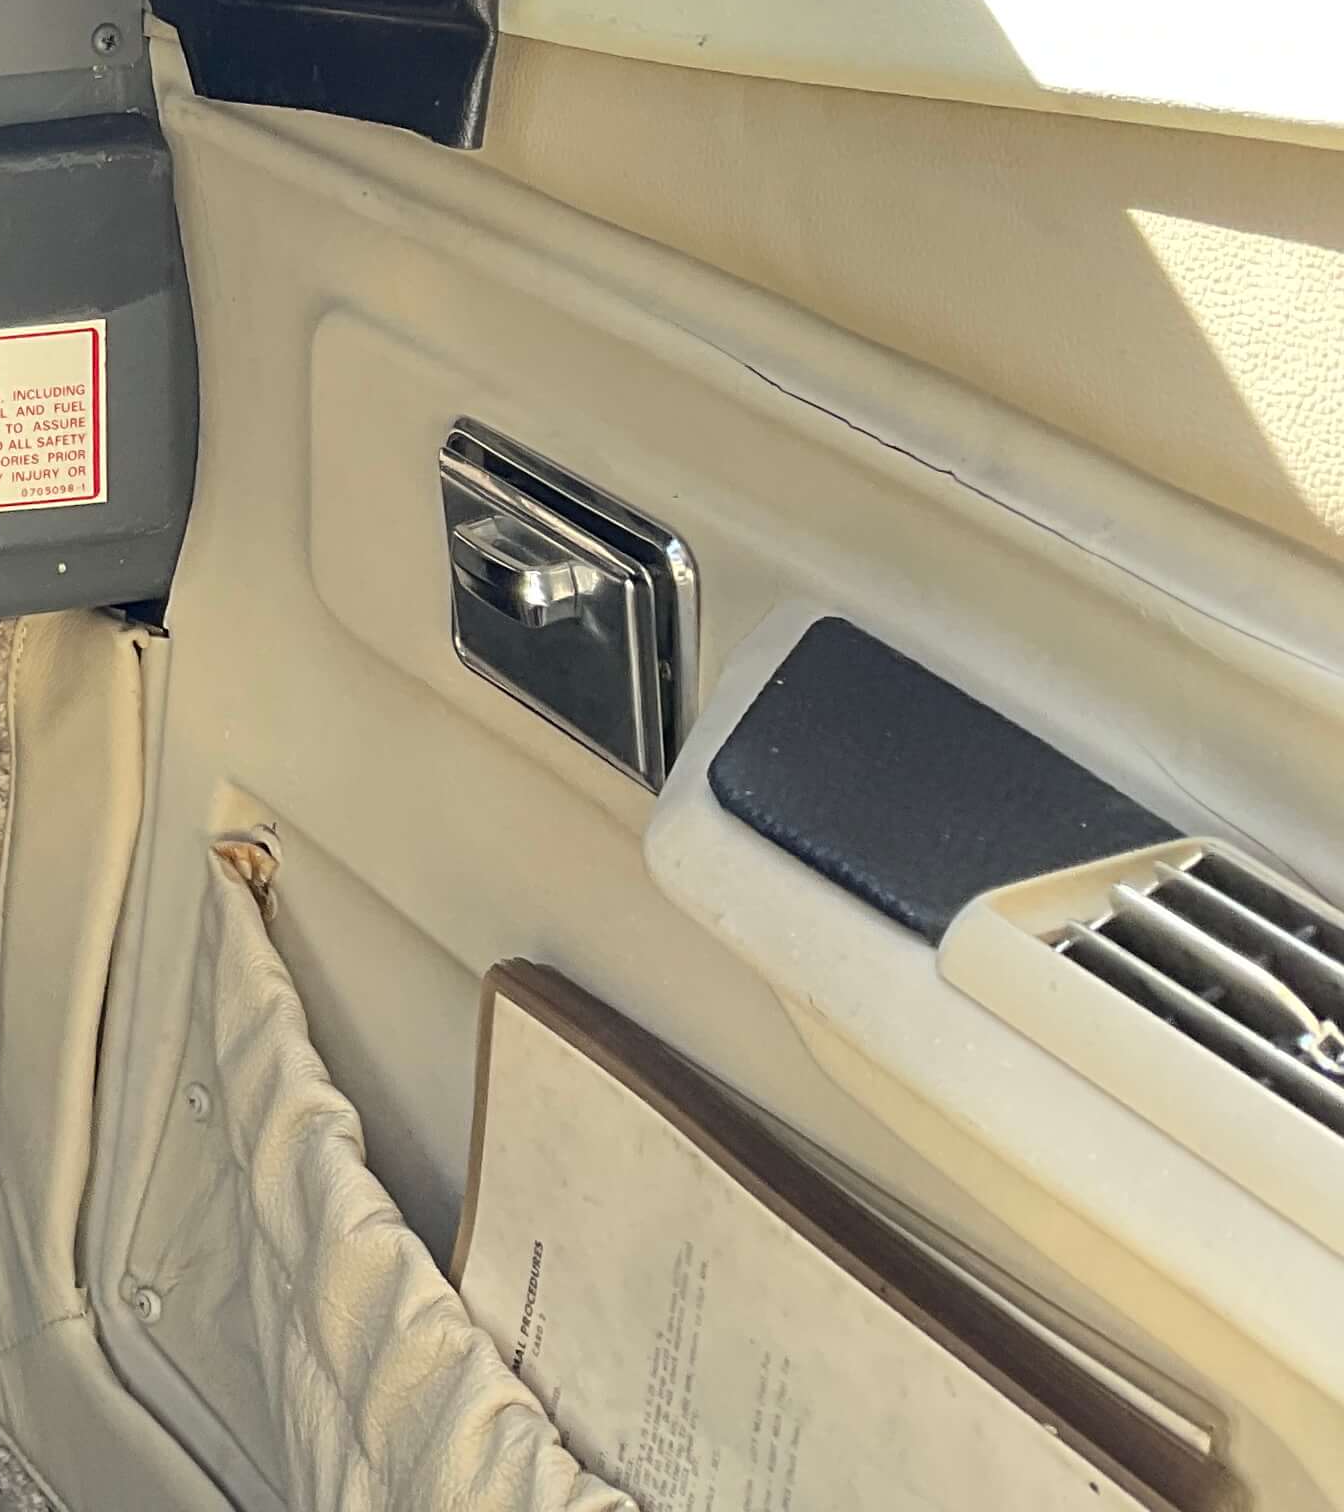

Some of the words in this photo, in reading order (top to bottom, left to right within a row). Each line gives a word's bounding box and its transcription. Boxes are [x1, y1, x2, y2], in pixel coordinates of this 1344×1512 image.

[13, 384, 85, 400] INCLUDING
[16, 404, 45, 417] AND
[54, 401, 85, 413] FUEL
[6, 423, 23, 434] TO
[33, 418, 85, 432] ASSURE
[9, 438, 32, 450] ALL
[37, 434, 86, 448] SAFETY
[48, 450, 86, 462] PRIOR
[12, 470, 59, 482] INJURY
[68, 466, 86, 477] OR
[520, 1239, 543, 1337] PROCEDURES
